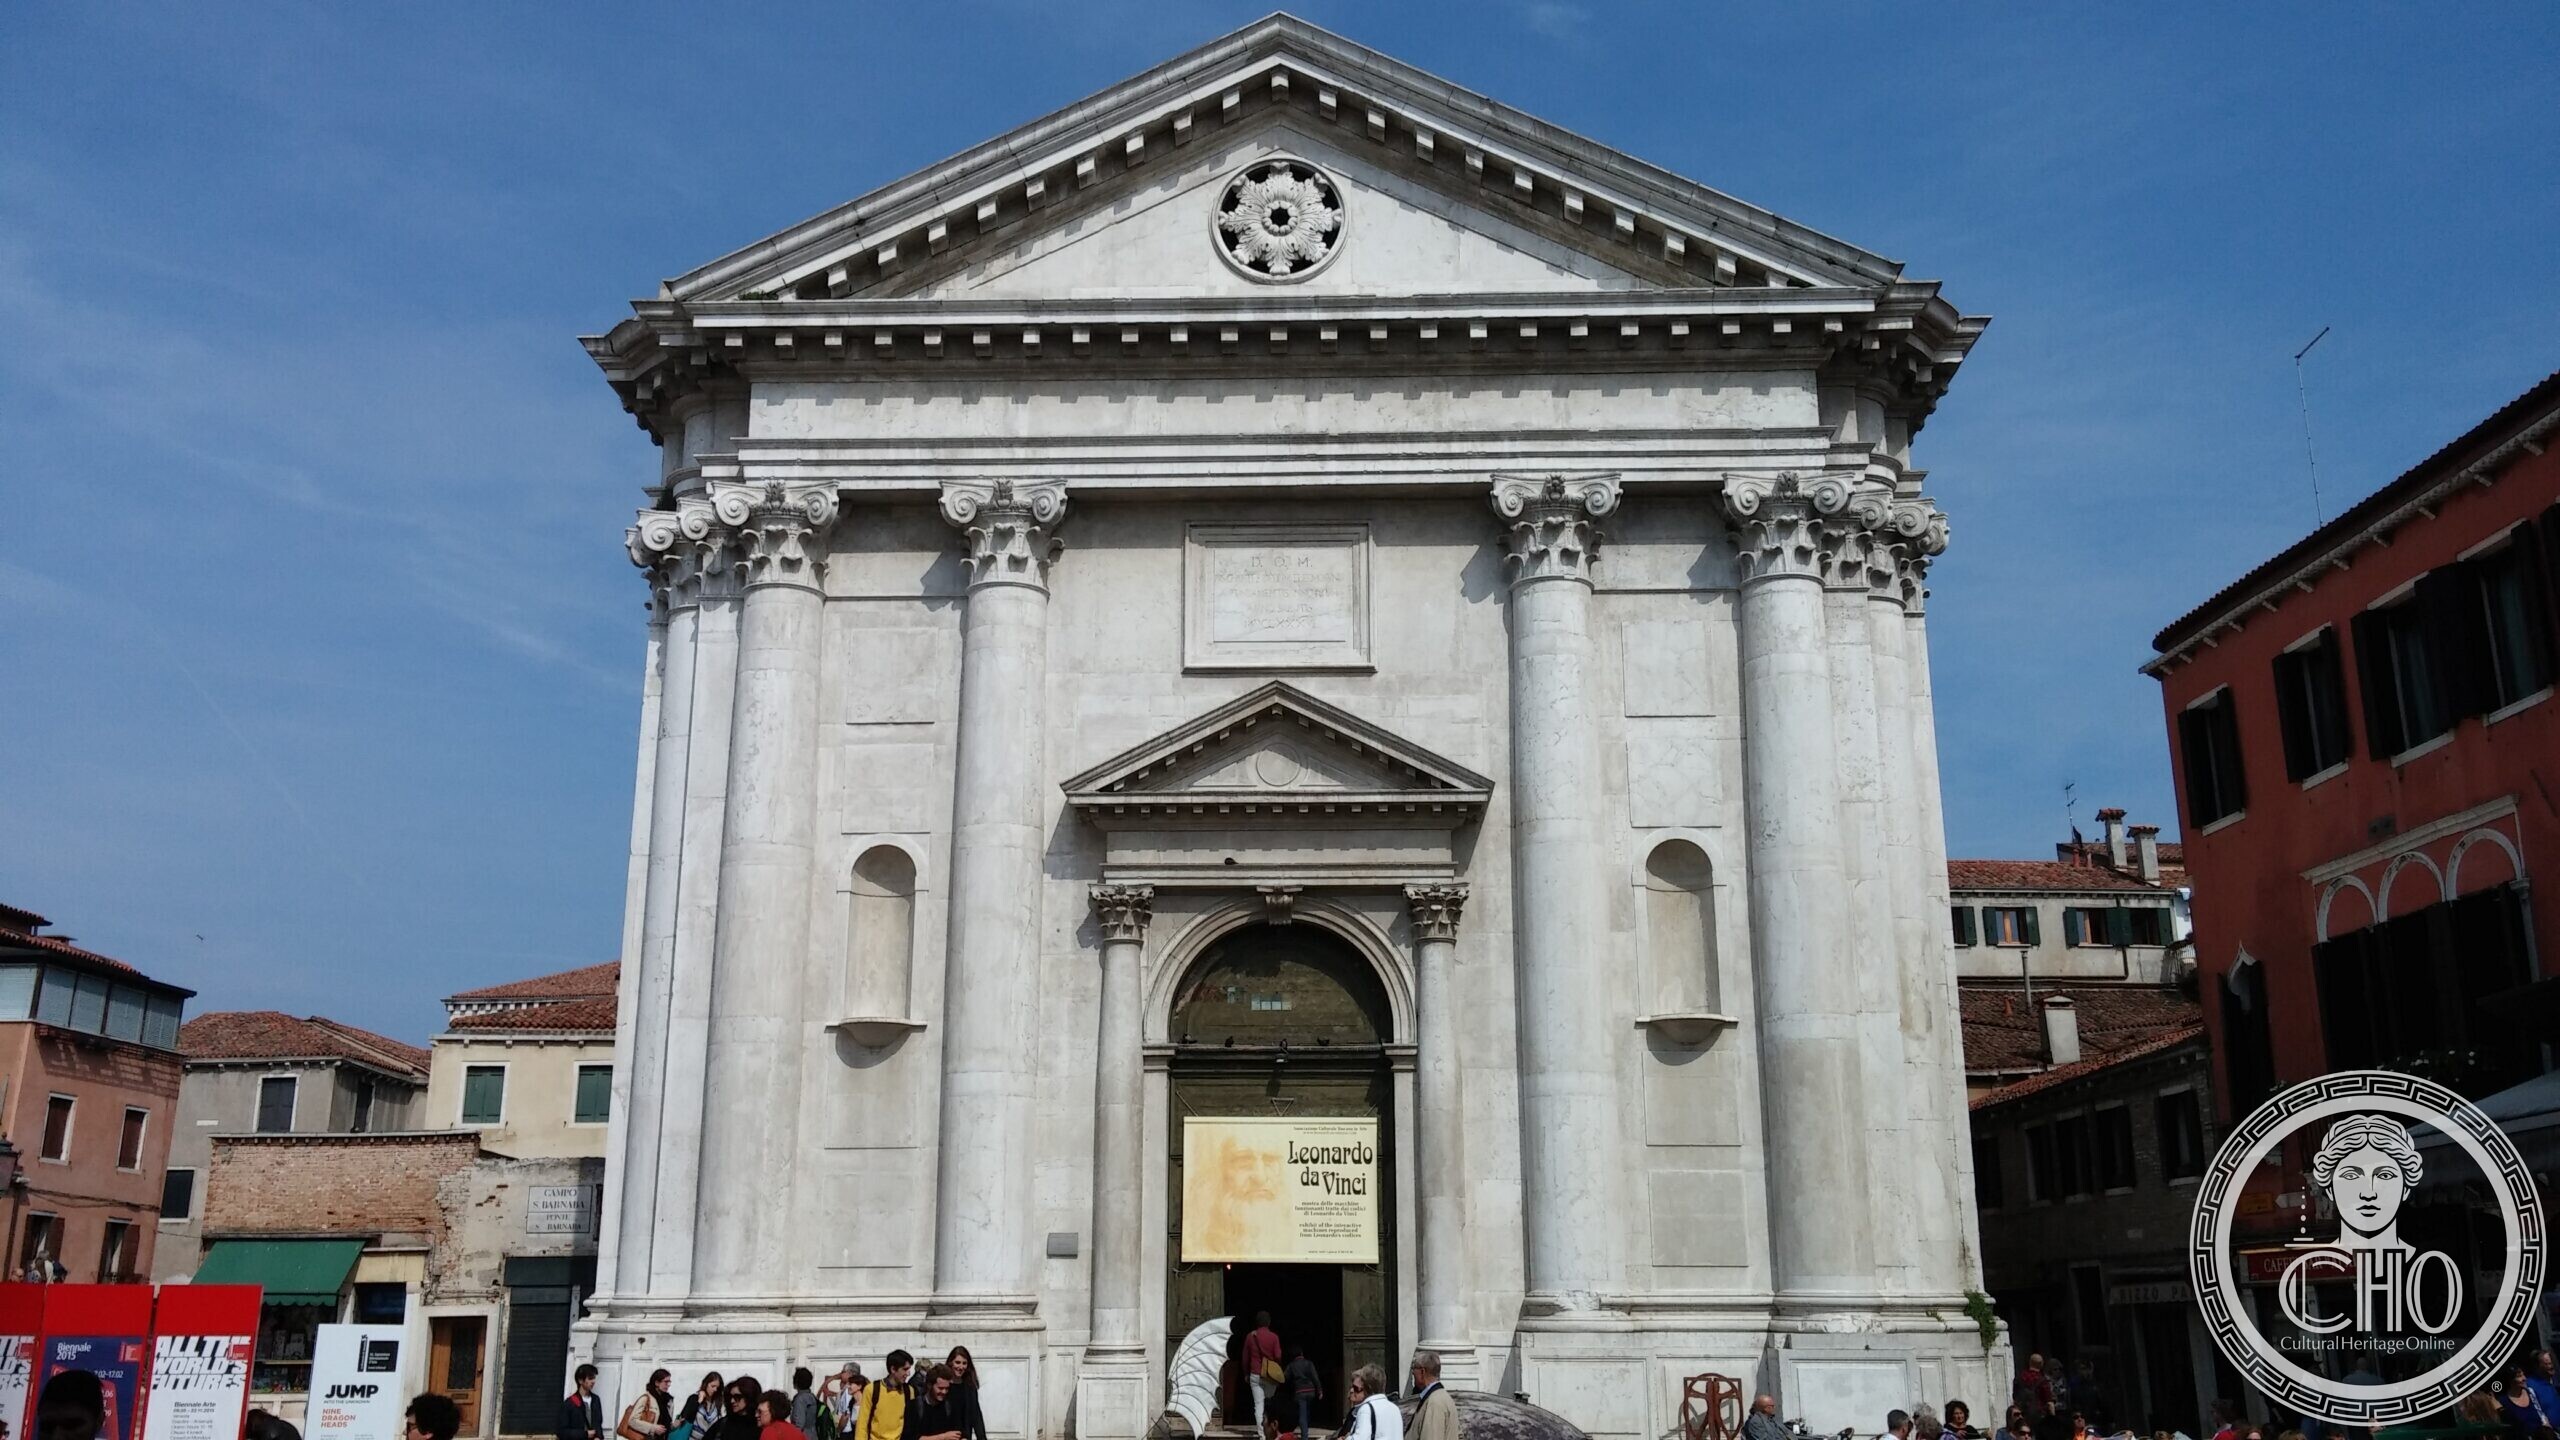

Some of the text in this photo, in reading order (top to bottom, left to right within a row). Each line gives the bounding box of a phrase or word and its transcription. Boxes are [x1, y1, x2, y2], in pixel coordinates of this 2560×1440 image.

[1288, 1141, 1373, 1164] Leonardo
[1301, 1167, 1367, 1195] da Vinci
[544, 1189, 577, 1197] CAMPO
[542, 1201, 584, 1209] BARNABA
[57, 1342, 91, 1352] Biennale
[56, 1351, 77, 1361] 2015
[152, 1374, 246, 1391] FUTURES
[325, 1385, 379, 1398] JUMP
